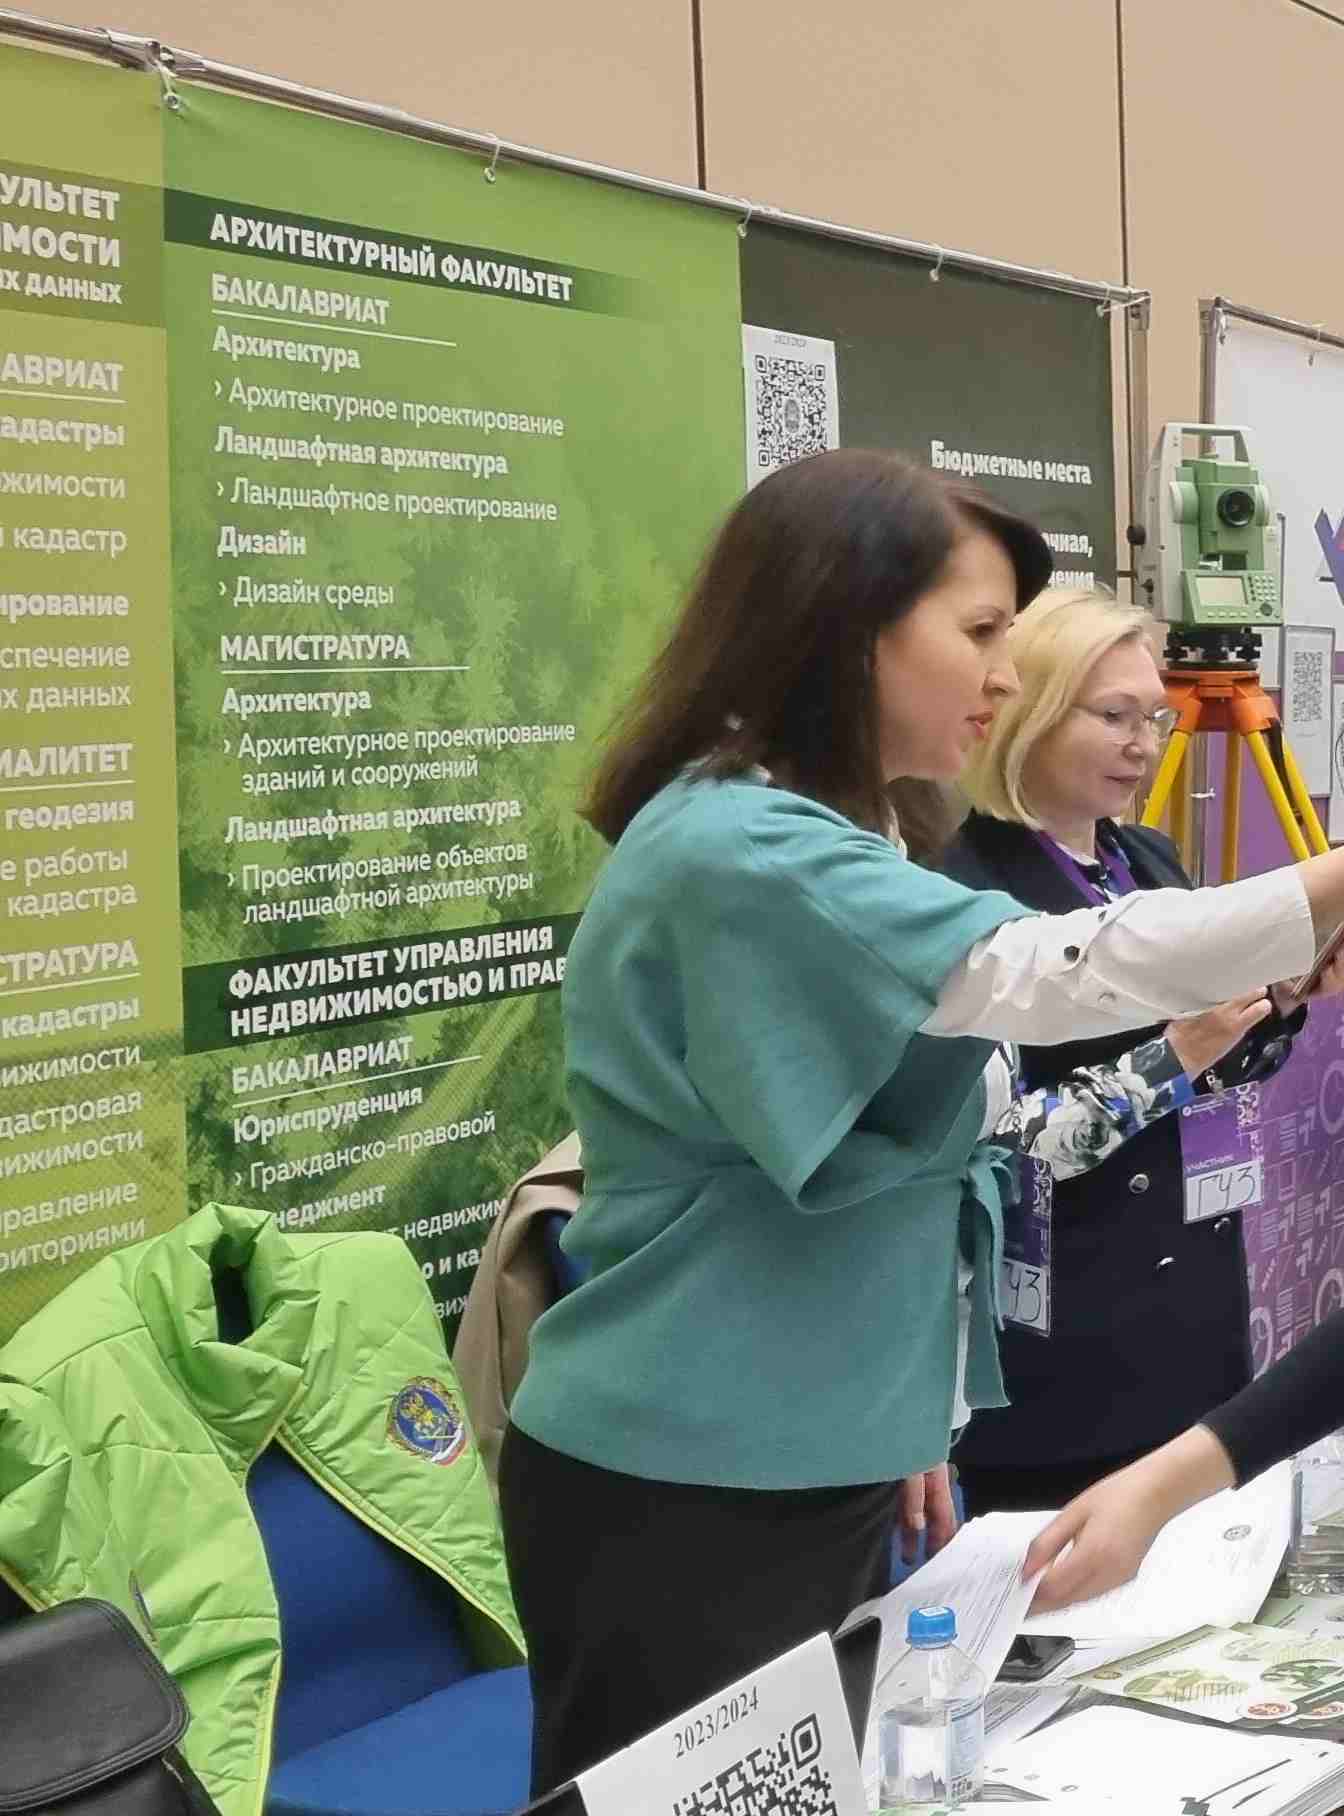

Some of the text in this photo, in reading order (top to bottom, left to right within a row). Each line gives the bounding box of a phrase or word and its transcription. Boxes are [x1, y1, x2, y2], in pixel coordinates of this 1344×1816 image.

[210, 213, 573, 301] АРХИТЕКТУРНЫЙ ФАКУЛЬТЕТ
[25, 272, 122, 304] ДАННЫХ
[211, 273, 389, 324] БАКАЛАВРИАТ
[213, 326, 361, 372] Архитектура
[0, 353, 123, 392] АВРИАТ
[229, 377, 564, 436] Архитектурное проектирование
[215, 426, 509, 478] Ландшафтная архитектура
[931, 440, 1092, 484] Бюджетные места
[231, 477, 557, 521] Ландшафтное проектирование
[14, 527, 128, 558] кадастр
[217, 526, 306, 557] Дизайн
[234, 576, 394, 609] Дизайн среды
[221, 634, 411, 661] МАГИСТРАТУРА
[26, 684, 131, 713] данных
[222, 688, 371, 720] Архитектура
[238, 722, 575, 763] Архитектурное проектирование
[242, 755, 479, 796] зданий и сооружений
[5, 800, 134, 830] геодезия
[224, 800, 521, 843] Ландшафтная архитектура
[25, 847, 128, 886] работы
[242, 840, 528, 893] Проектирование объектов
[8, 883, 138, 917] кадастра
[243, 872, 533, 924] ландшафтной архитектуры
[229, 926, 552, 999] ФАКУЛЬТЕТ УПРАВЛЕНИЯ
[1, 997, 139, 1039] кадастры
[231, 971, 483, 1037] НЕДВИЖИМОСТЬЮ
[488, 968, 504, 993] И
[233, 1036, 413, 1095] БАКАЛАВРИАТ
[234, 1087, 423, 1144] Юриспруденция
[250, 1111, 495, 1191] Гражданско-правовой
[0, 1183, 138, 1237] равление
[674, 1685, 760, 1758] 2023/2024
